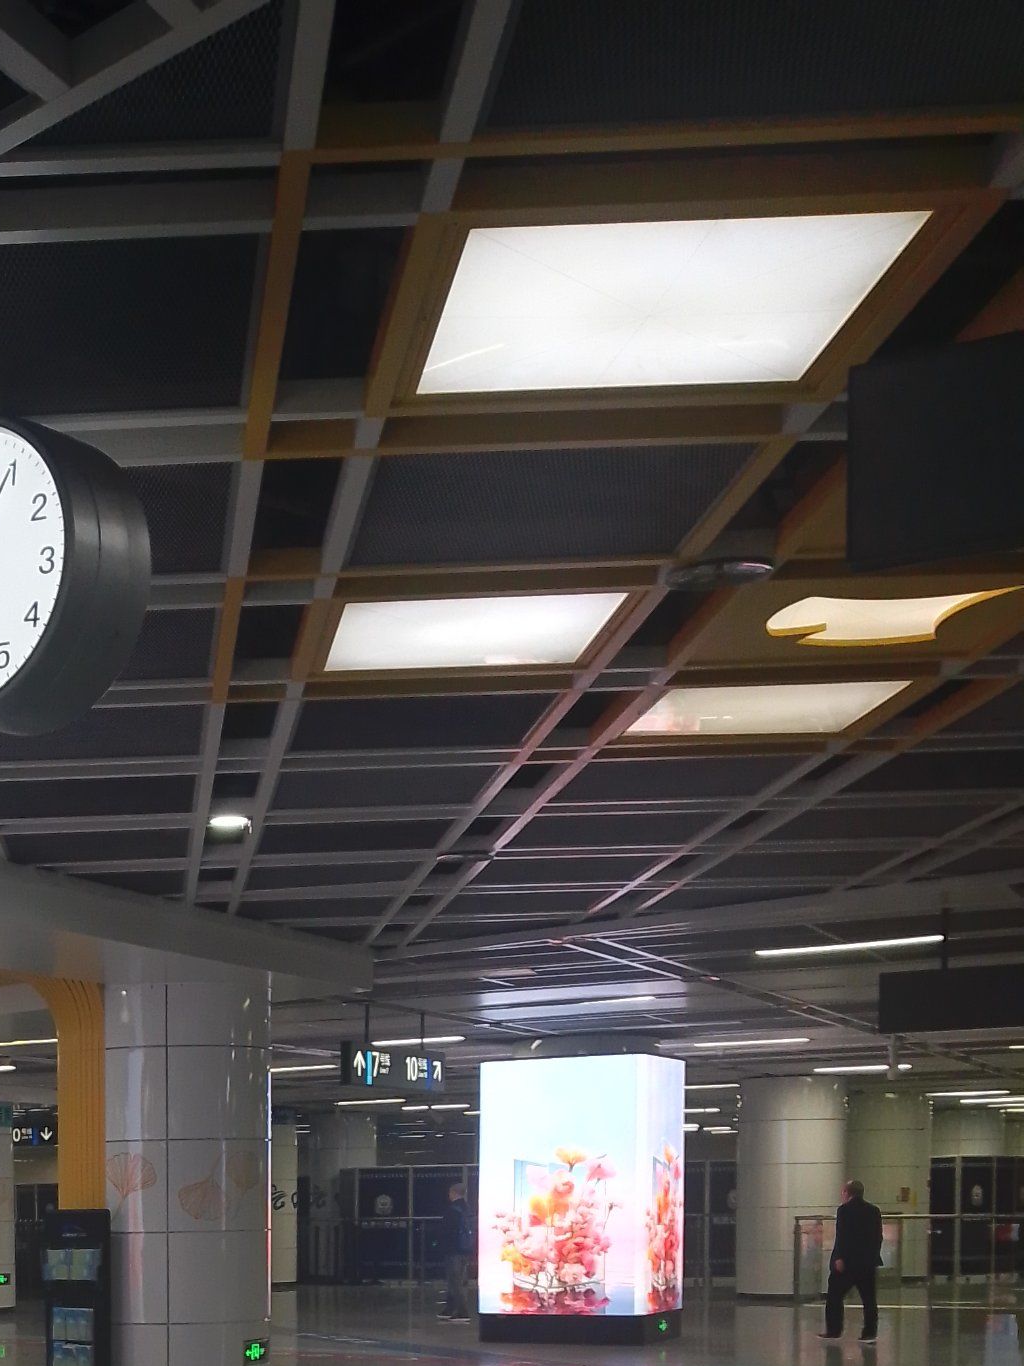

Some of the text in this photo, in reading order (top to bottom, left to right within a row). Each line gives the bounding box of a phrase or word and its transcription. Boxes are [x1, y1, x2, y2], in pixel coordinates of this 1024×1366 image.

[30, 493, 48, 521] 2
[38, 546, 55, 574] 3
[23, 601, 40, 628] 4
